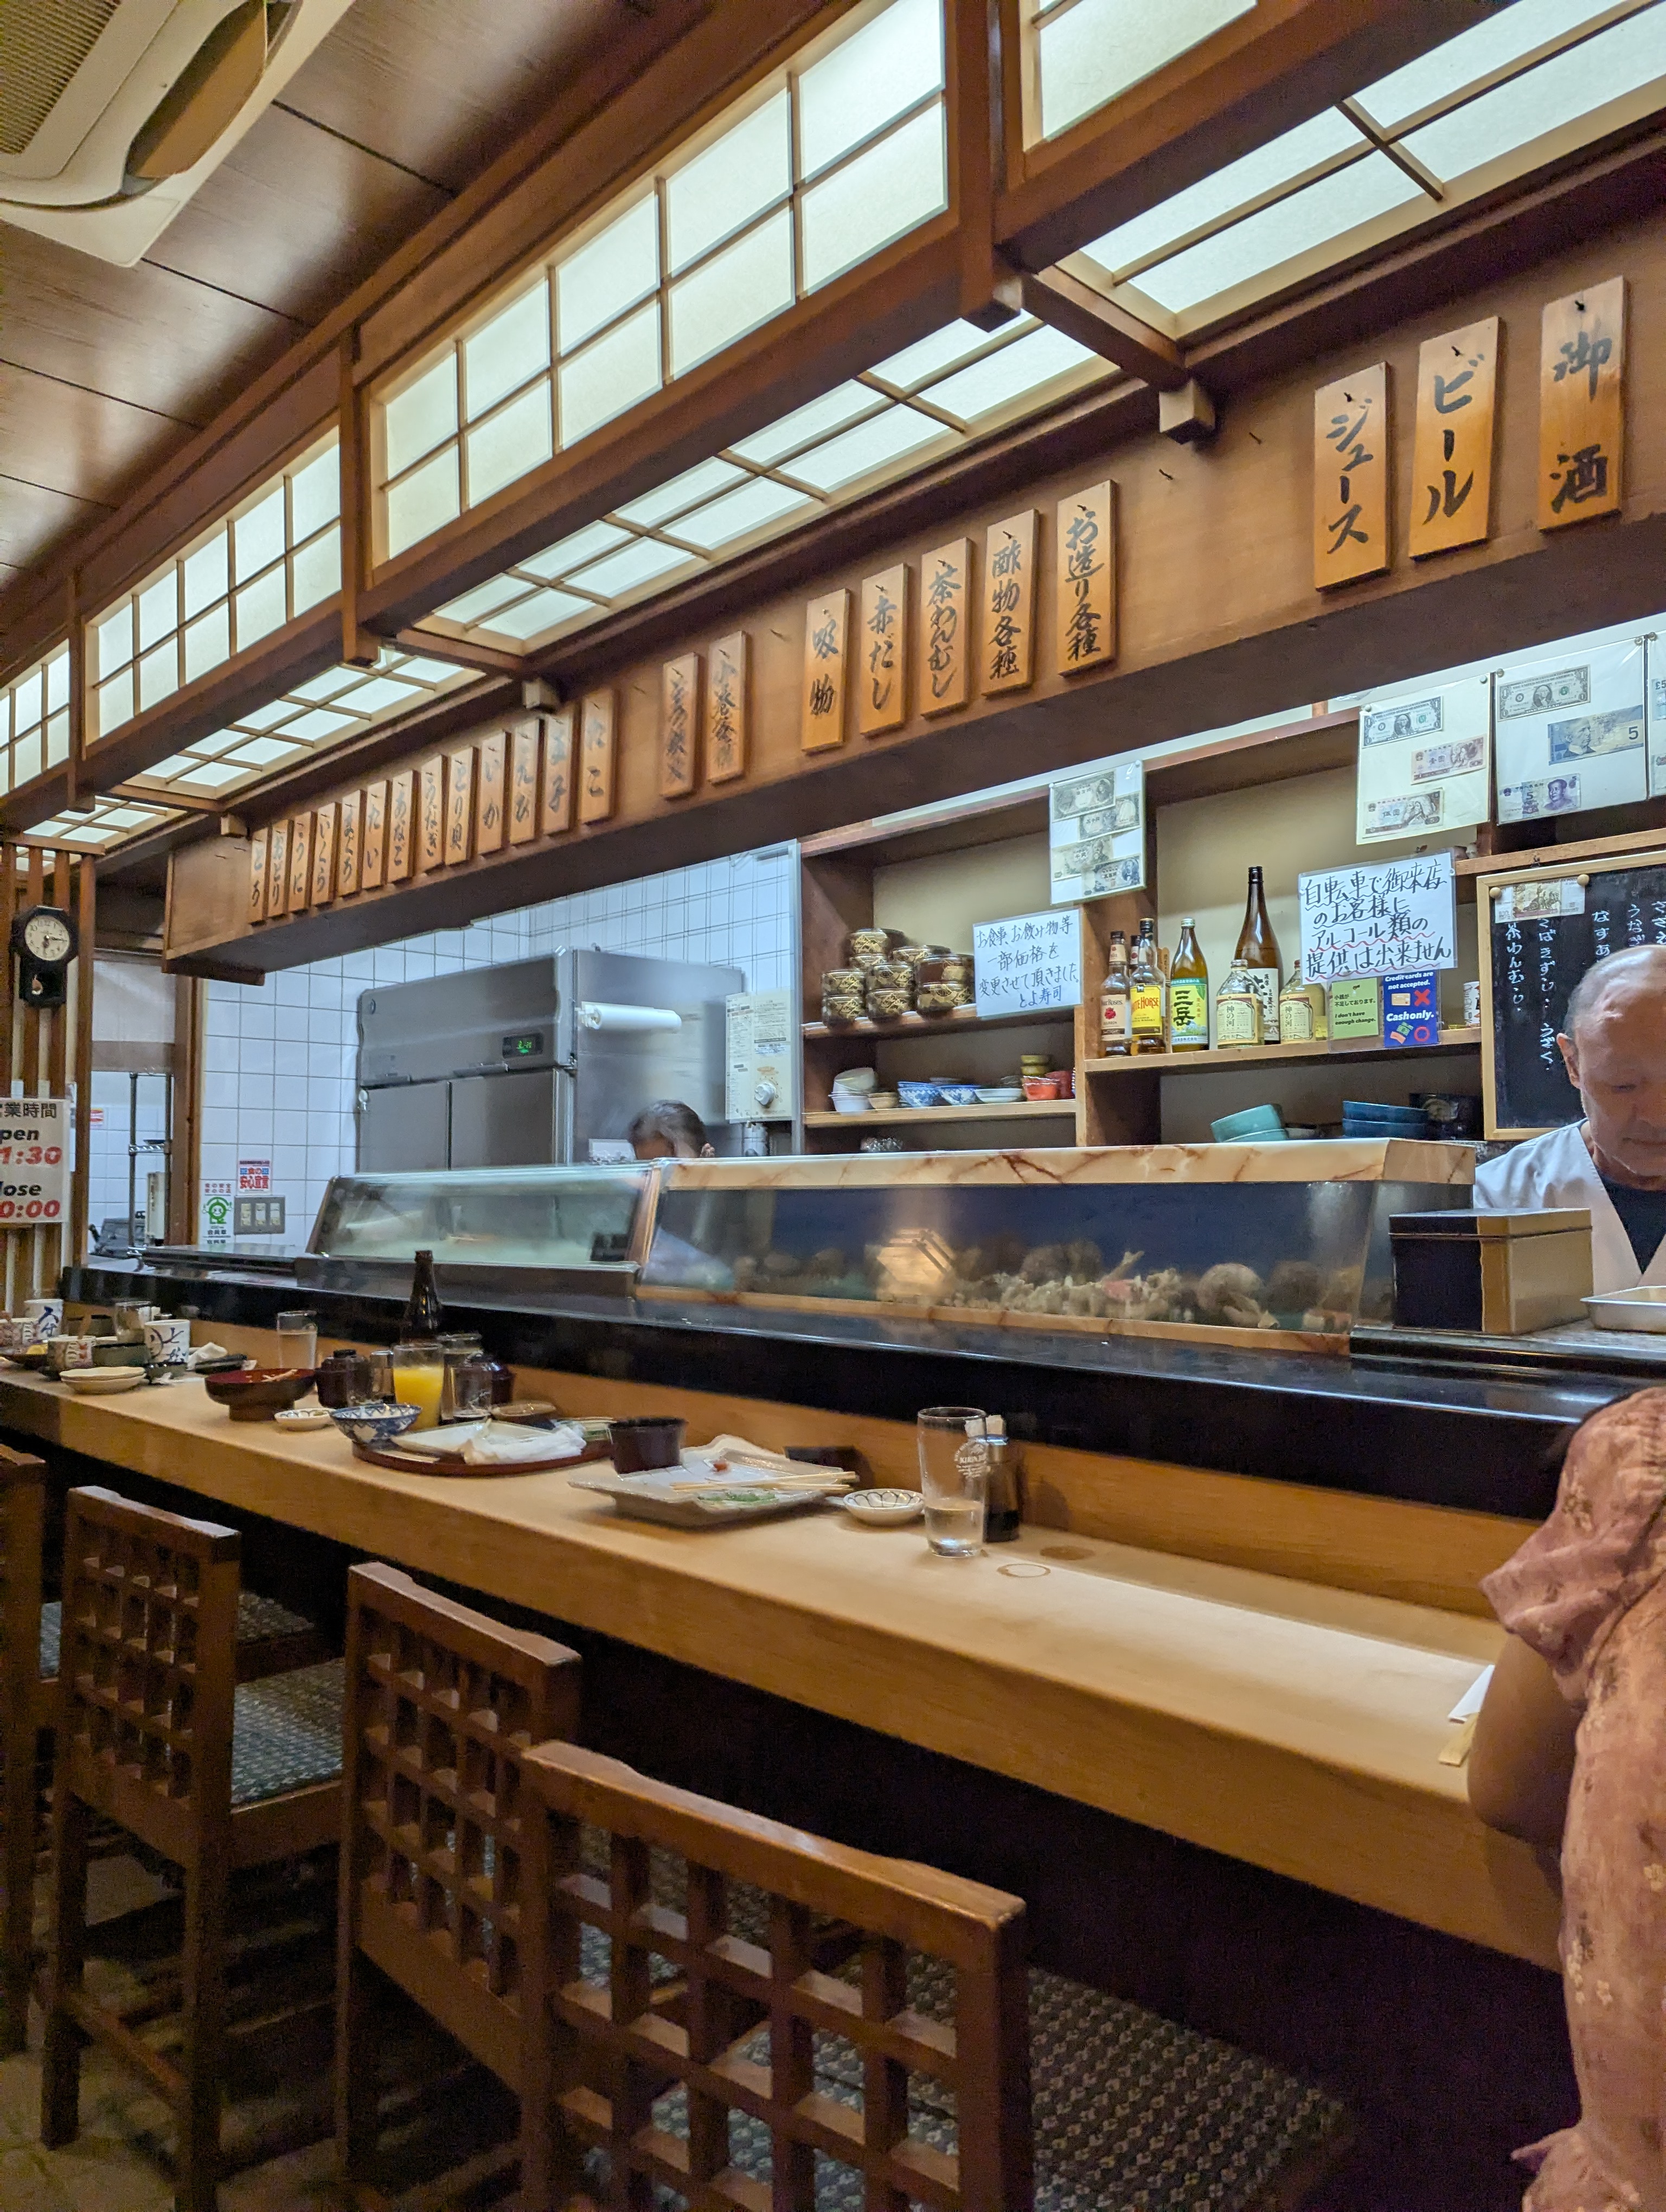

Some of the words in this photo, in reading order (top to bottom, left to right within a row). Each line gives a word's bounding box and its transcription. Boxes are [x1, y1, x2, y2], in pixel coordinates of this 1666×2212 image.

[1549, 325, 1613, 514] 御酒
[1421, 353, 1485, 526] ビール
[1325, 398, 1374, 555] ジュース
[1065, 511, 1105, 661] お造り各種
[988, 540, 1022, 681] 酢物各種
[927, 564, 962, 699] 茶わんむし
[867, 595, 897, 710] 赤だし
[1629, 726, 1638, 740] 5
[1526, 792, 1534, 800] 5
[1305, 859, 1447, 905] 自転車で御来店
[1314, 893, 1411, 925] のお客様に
[1311, 914, 1428, 949] アルコール類の
[1592, 910, 1610, 961] なすあ
[988, 942, 1059, 971] 一部価格を
[1306, 936, 1451, 978] 提供は出来ません
[979, 963, 1079, 996] 変更させて頂きました。
[1020, 985, 1062, 1008] とよ寿司
[1400, 980, 1430, 988] accepted.
[1140, 996, 1159, 1009] HORSE
[1174, 990, 1195, 1026] 三岳
[1226, 1006, 1235, 1027] 神の河
[1334, 999, 1376, 1007] 不足しております。
[0, 1102, 56, 1118] 業時間
